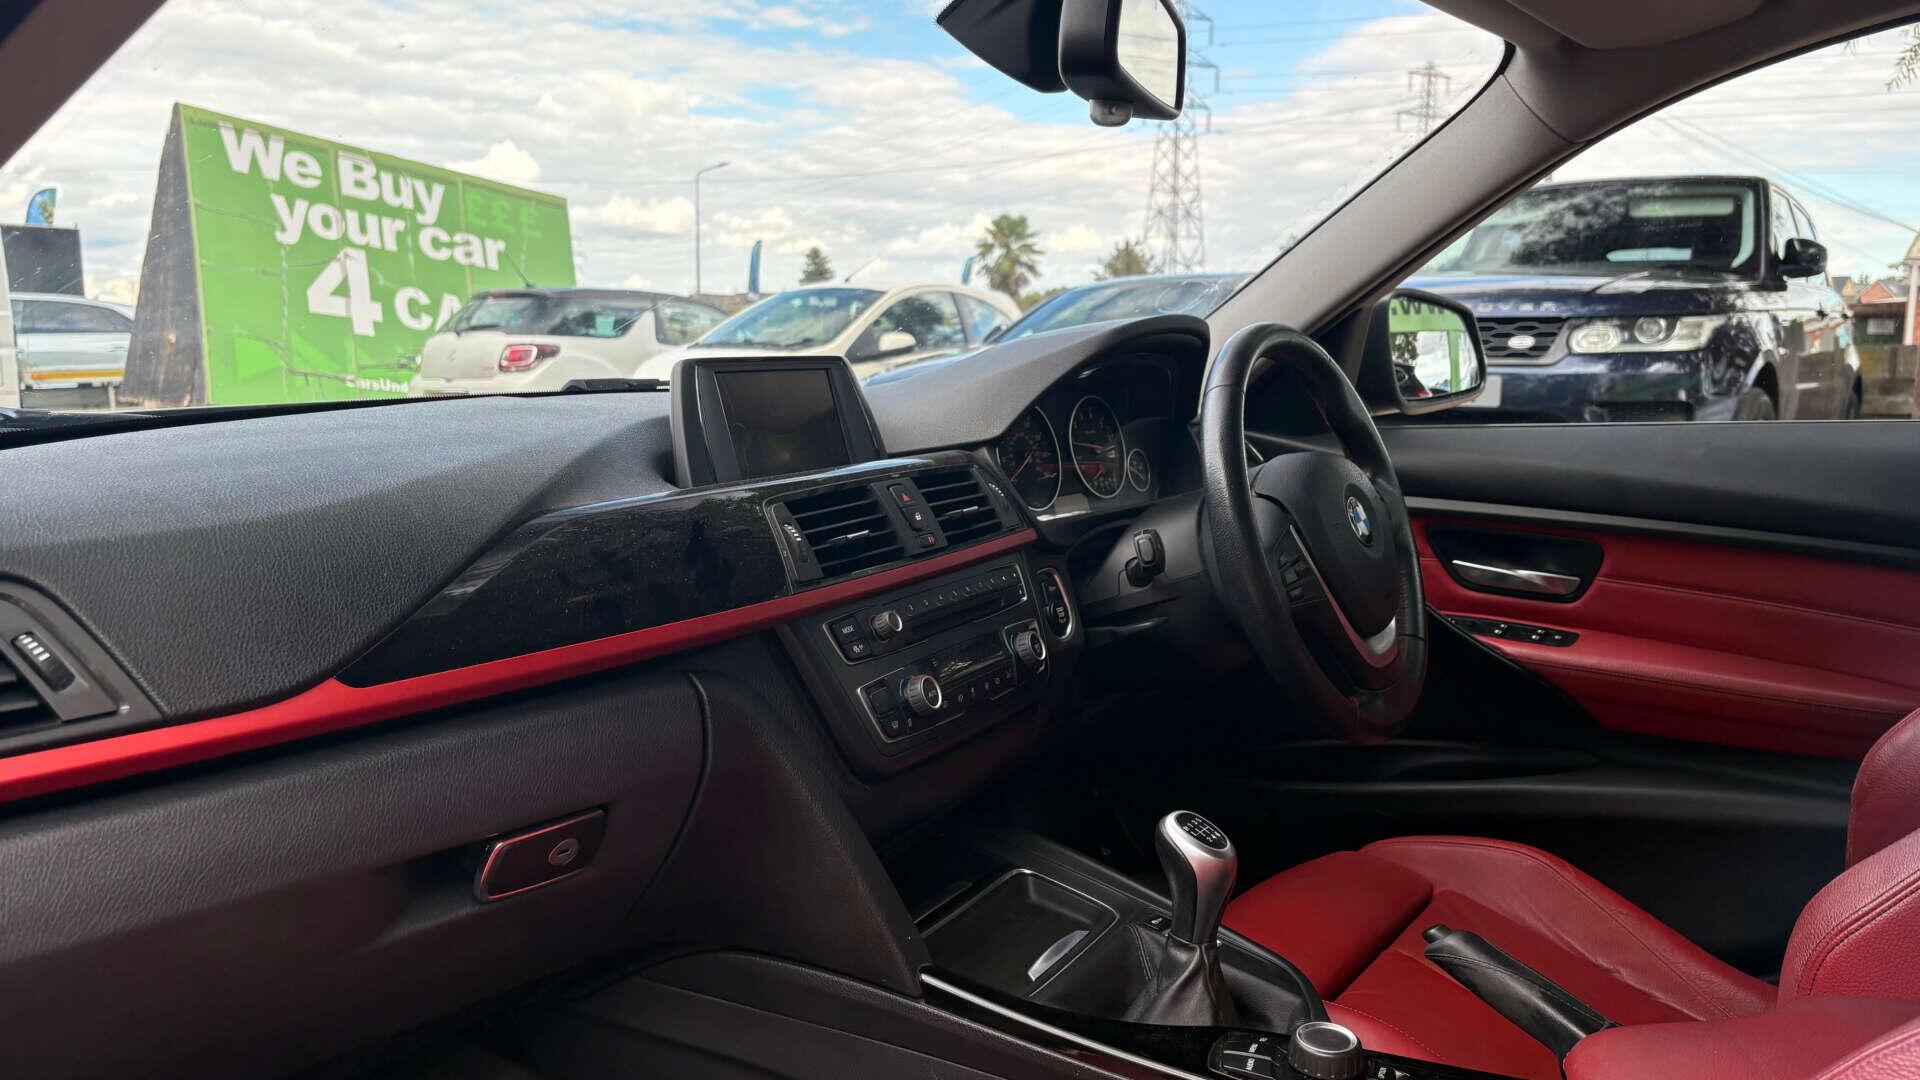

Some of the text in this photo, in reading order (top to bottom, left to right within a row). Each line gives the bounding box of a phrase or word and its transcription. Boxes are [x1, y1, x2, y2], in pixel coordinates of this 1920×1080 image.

[218, 121, 446, 225] We Buy
[270, 192, 506, 272] your car
[306, 247, 383, 337] 4
